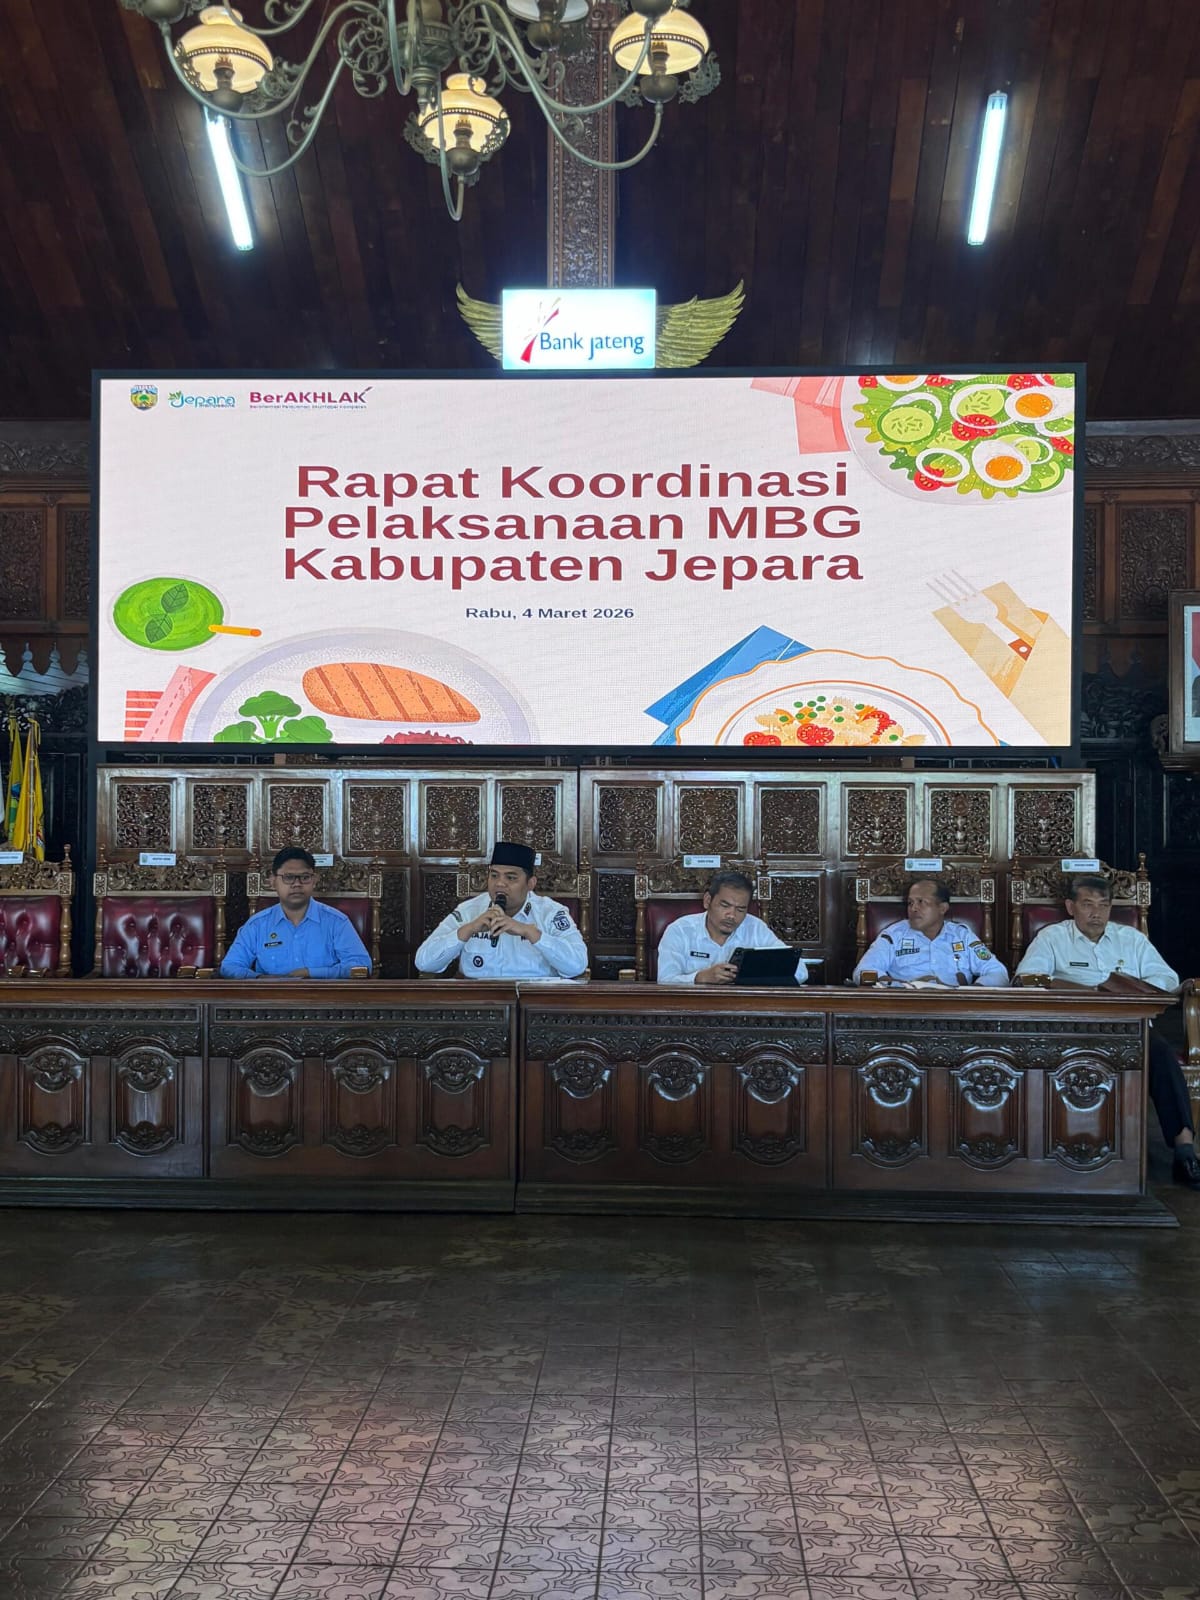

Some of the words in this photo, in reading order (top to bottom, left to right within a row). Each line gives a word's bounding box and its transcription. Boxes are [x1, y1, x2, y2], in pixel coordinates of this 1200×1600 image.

[540, 332, 583, 350] Bank
[170, 393, 236, 409] Jepara
[249, 390, 368, 404] BerAKHLAK
[298, 465, 479, 507] Rapat
[501, 462, 847, 499] Koordinasi
[285, 505, 684, 540] Pelaksanaan
[708, 506, 861, 540] MBG
[285, 547, 623, 590] Kabupaten
[644, 548, 864, 591] Jepara
[465, 607, 517, 620] Rabu,
[522, 607, 533, 619] 4
[538, 607, 588, 619] Maret
[593, 608, 635, 619] 2026
